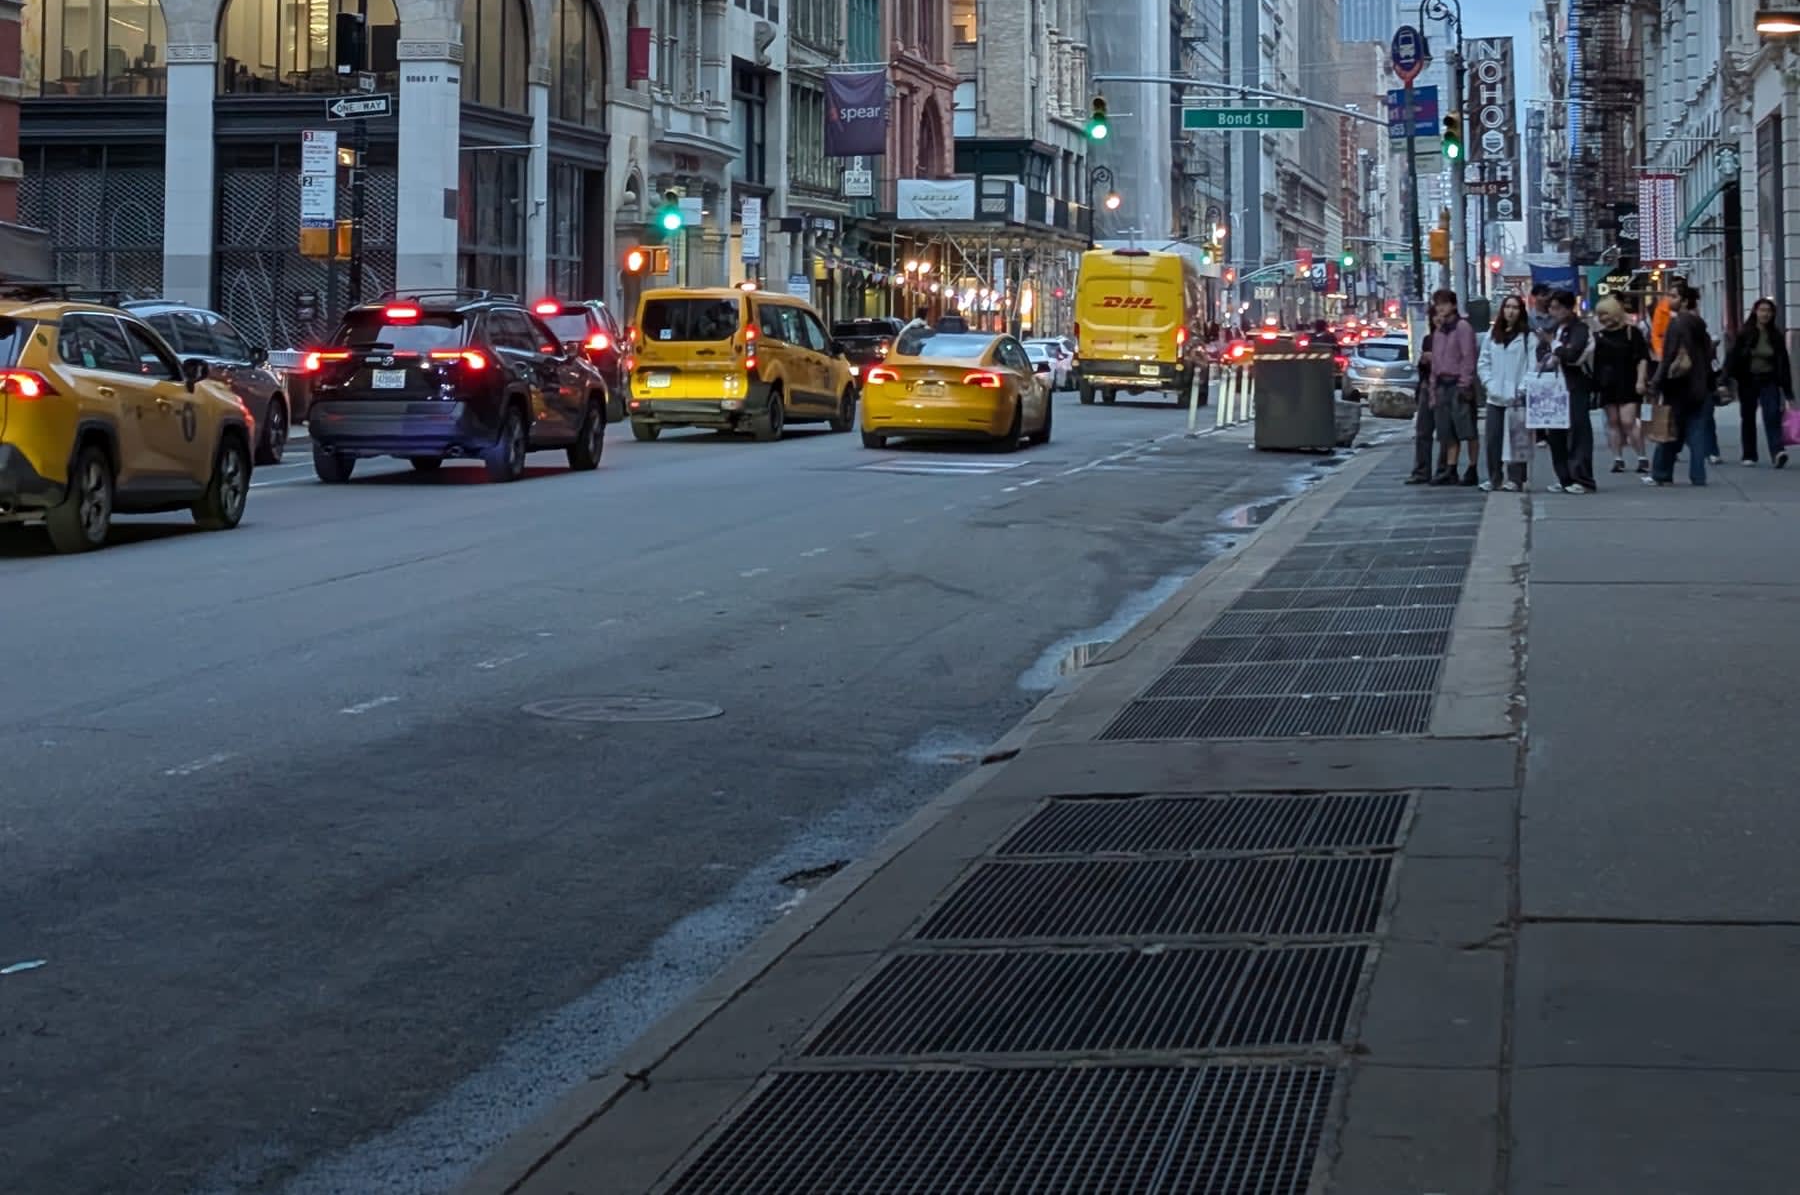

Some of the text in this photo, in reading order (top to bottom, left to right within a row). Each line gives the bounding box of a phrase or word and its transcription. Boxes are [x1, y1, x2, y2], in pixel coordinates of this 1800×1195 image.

[1479, 40, 1504, 129] NOHO
[337, 101, 382, 113] ONE WAY
[840, 106, 881, 123] spear
[1218, 112, 1269, 125] Bond St
[1103, 296, 1156, 310] DHL
